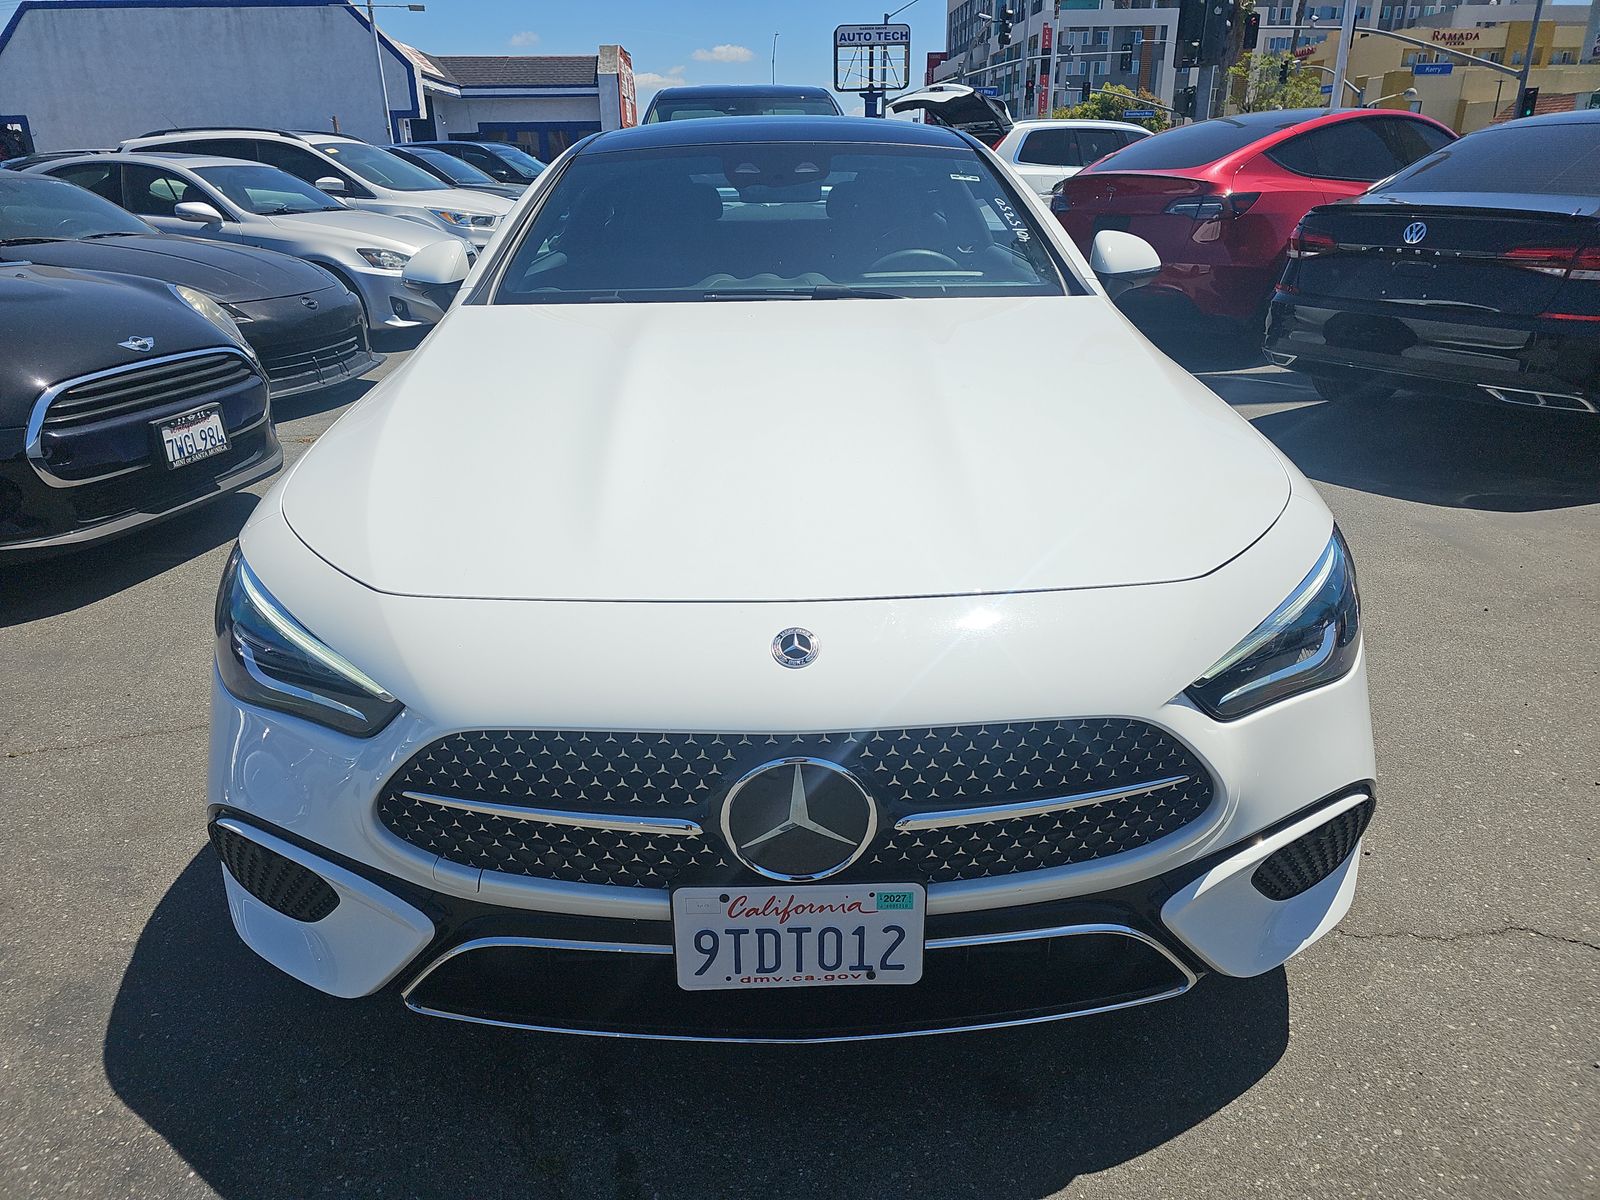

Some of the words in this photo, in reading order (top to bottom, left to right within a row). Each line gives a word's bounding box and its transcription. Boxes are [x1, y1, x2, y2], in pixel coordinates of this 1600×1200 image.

[839, 32, 872, 42] AUTO
[876, 31, 908, 41] TECH
[1432, 30, 1480, 41] RAMADA
[1361, 246, 1461, 257] PASSAT
[166, 425, 226, 460] 7WGL984
[173, 459, 186, 468] MINI
[192, 451, 209, 461] SANTA
[208, 445, 228, 456] MONICA
[883, 894, 907, 903] 2027
[728, 894, 879, 925] California
[694, 925, 906, 976] 9TDT012
[740, 973, 862, 984] dmv.ca.gov
